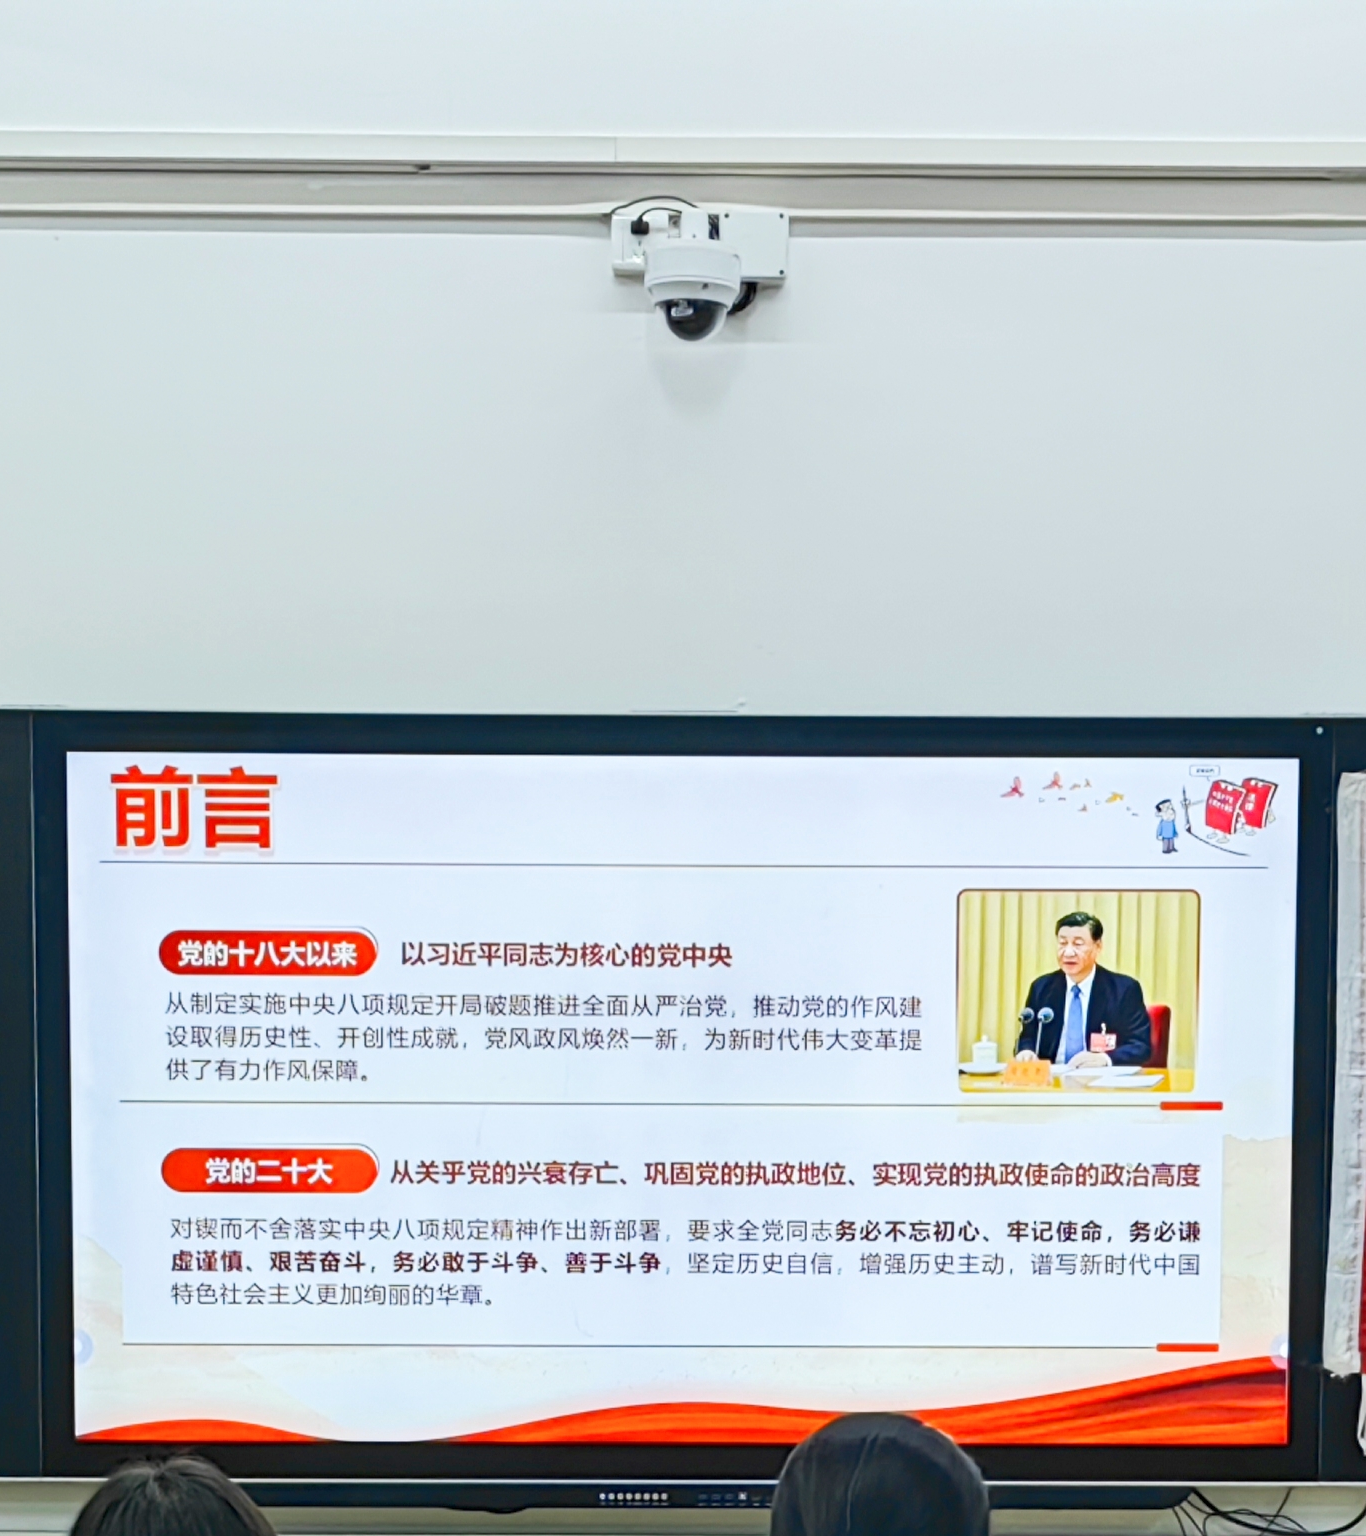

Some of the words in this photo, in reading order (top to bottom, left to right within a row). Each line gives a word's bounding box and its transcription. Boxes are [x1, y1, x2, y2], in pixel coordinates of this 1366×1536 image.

[110, 764, 279, 849] 前言
[177, 939, 358, 968] 党的十八大以来
[401, 940, 733, 969] 以习近平同志为核心的党中央
[165, 991, 923, 1018] 从制定实施中央八项规定开局破题推进全面从严治党，推动党的作风建
[165, 1024, 923, 1052] 设取得历史性、开创性成就，党风政风焕然一新，为新时代伟大变革提
[165, 1057, 368, 1082] 供了有力作风保障。
[205, 1157, 333, 1185] 党的二十大
[390, 1158, 1202, 1188] 从关乎党的兴衰存亡、巩固党的执政地位、实现党的执政使命的政治高度
[170, 1216, 1201, 1244] 对锲而不舍落实中央八项规定精神作出新部署，要求全党同志务必不忘初心、牢记使命，务必谦
[170, 1248, 1201, 1277] 虚谨慎、艰苦奋斗，务必敢于斗争、善于斗争，坚定历史自信，增强历史主动，谱写新时代中国
[170, 1281, 493, 1307] 特色社会主义更加绚丽的华章。
